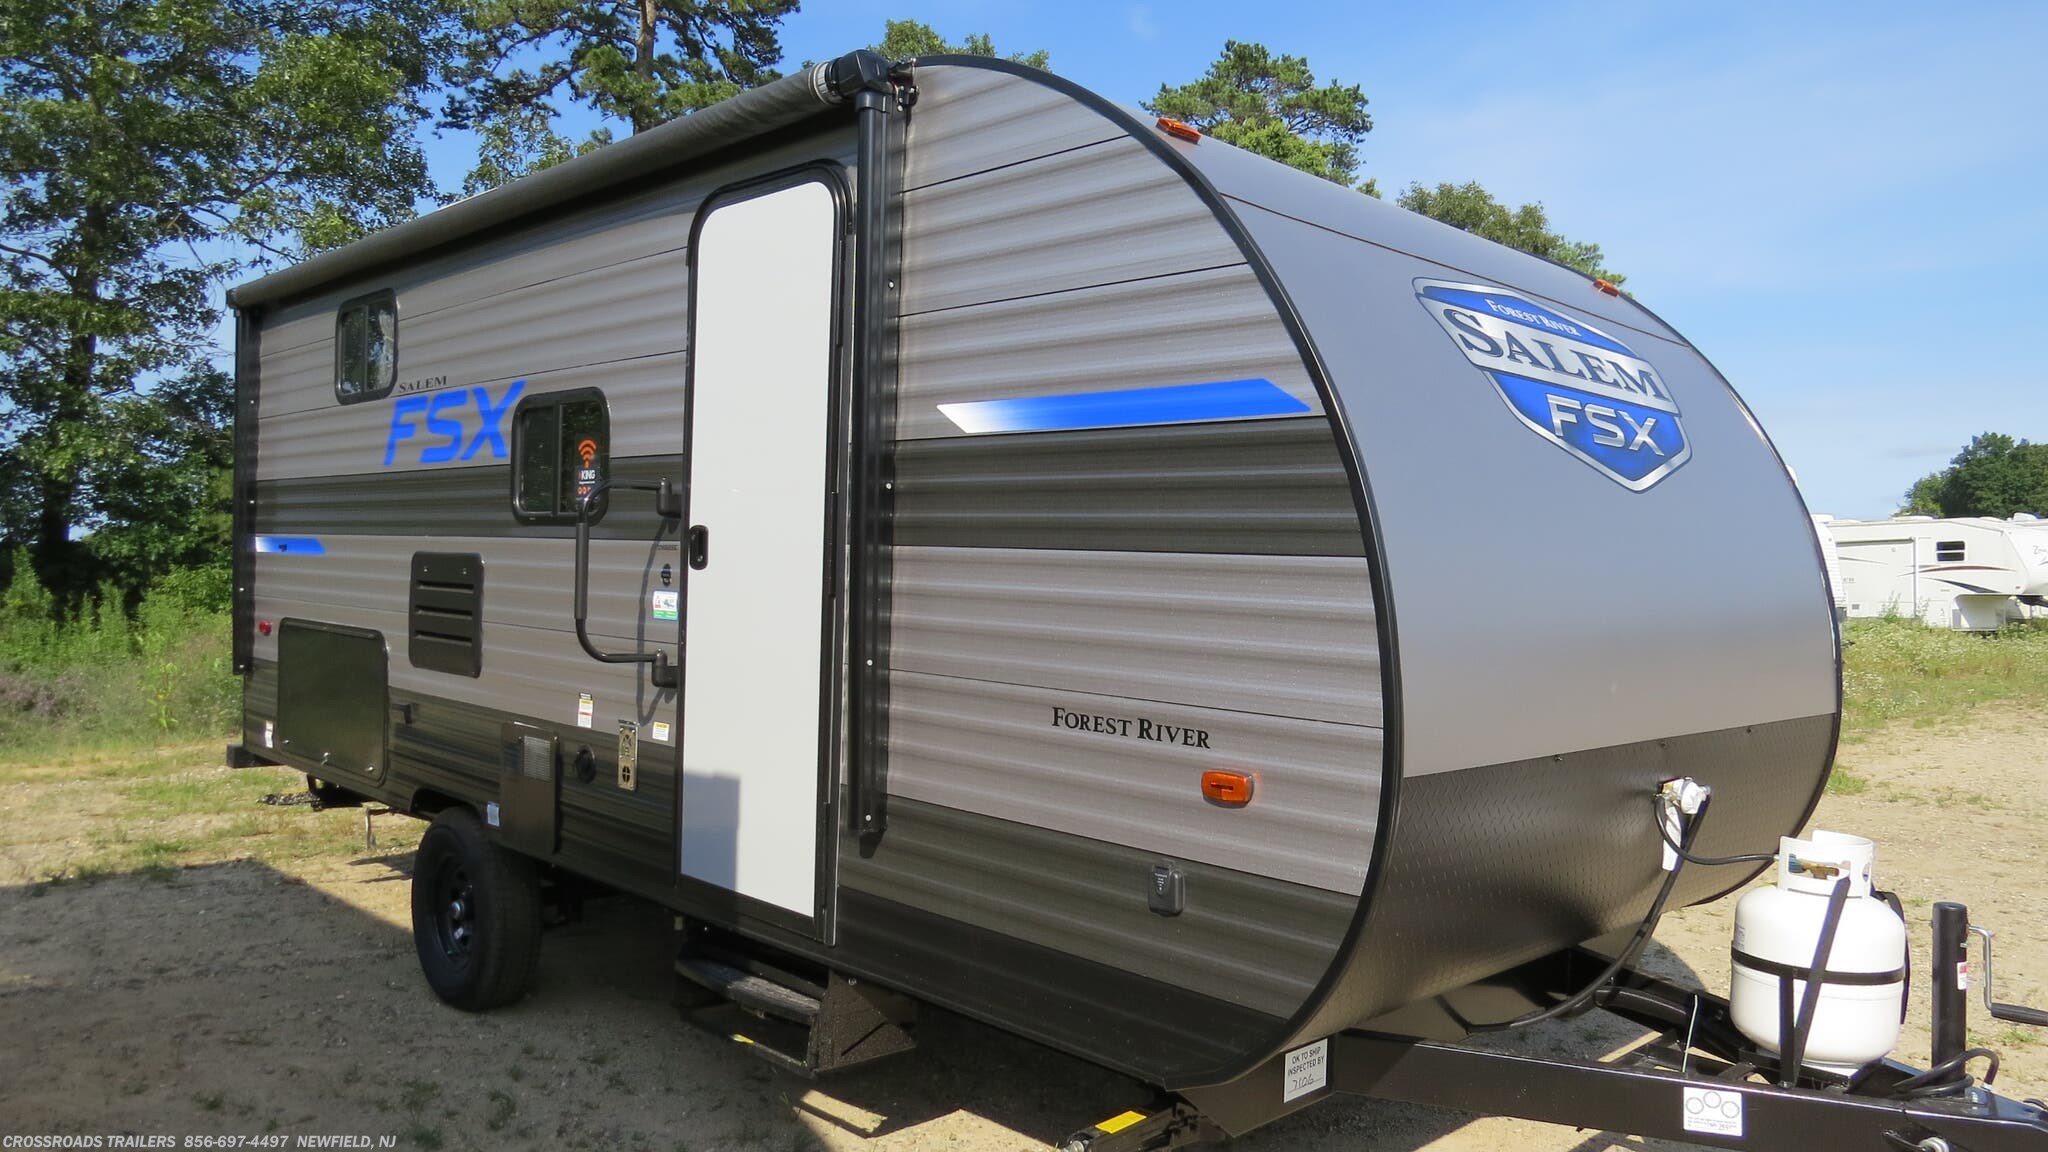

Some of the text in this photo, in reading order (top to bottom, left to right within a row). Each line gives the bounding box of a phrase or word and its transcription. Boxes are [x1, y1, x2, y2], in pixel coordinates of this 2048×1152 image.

[1485, 298, 1582, 337] FOREST RIVER
[1443, 308, 1673, 403] SALEM
[399, 375, 448, 393] SALEM
[384, 378, 528, 466] FSX
[1545, 393, 1665, 457] FSX
[1051, 706, 1211, 749] FOREST RIVER
[1287, 1055, 1325, 1077] INSPECTED BY
[1291, 1055, 1300, 1065] OK
[1301, 1051, 1308, 1061] TO
